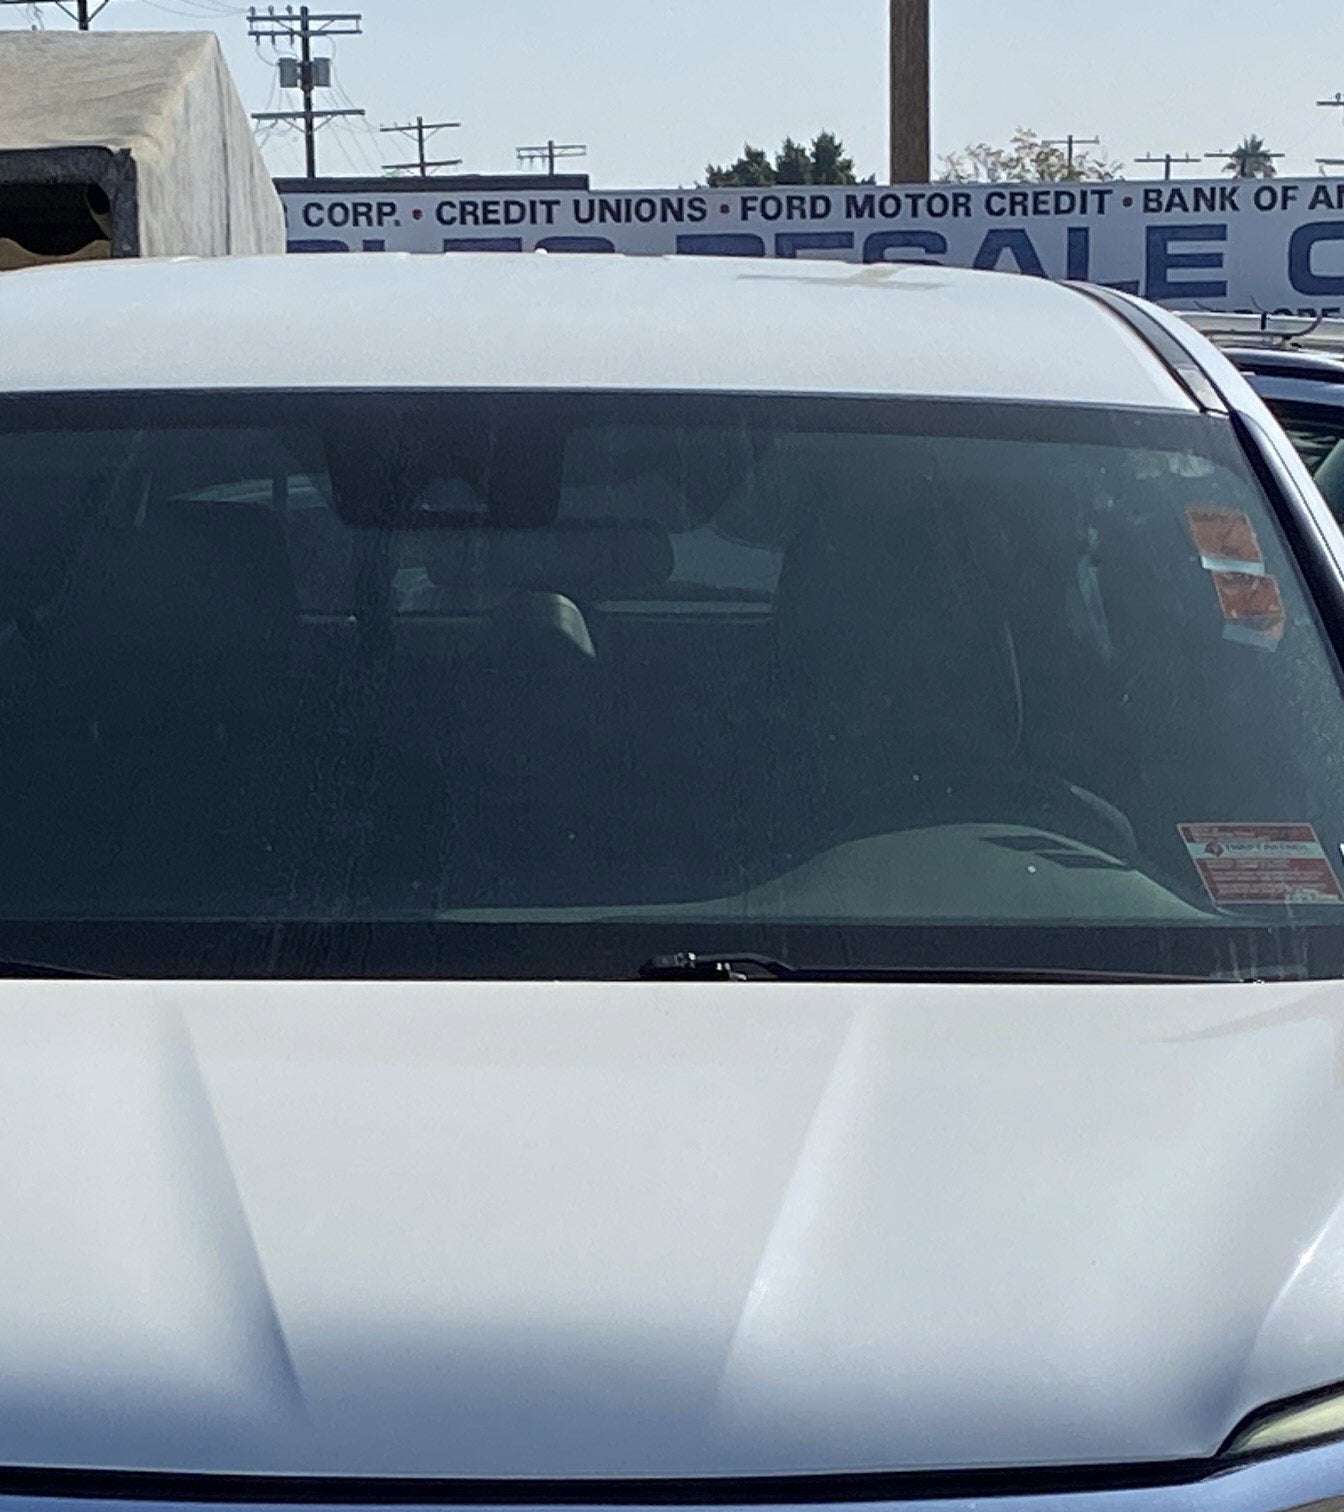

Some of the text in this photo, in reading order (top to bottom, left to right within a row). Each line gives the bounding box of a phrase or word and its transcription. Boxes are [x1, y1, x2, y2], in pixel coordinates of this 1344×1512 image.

[302, 202, 402, 228] CORP.
[435, 199, 561, 226] CREDIT
[573, 196, 708, 225] UNIONS
[740, 194, 832, 222] FORD
[845, 191, 972, 219] MOTOR
[984, 188, 1113, 217] CREDIT
[1142, 185, 1240, 214] BANK
[1253, 184, 1299, 211] OF
